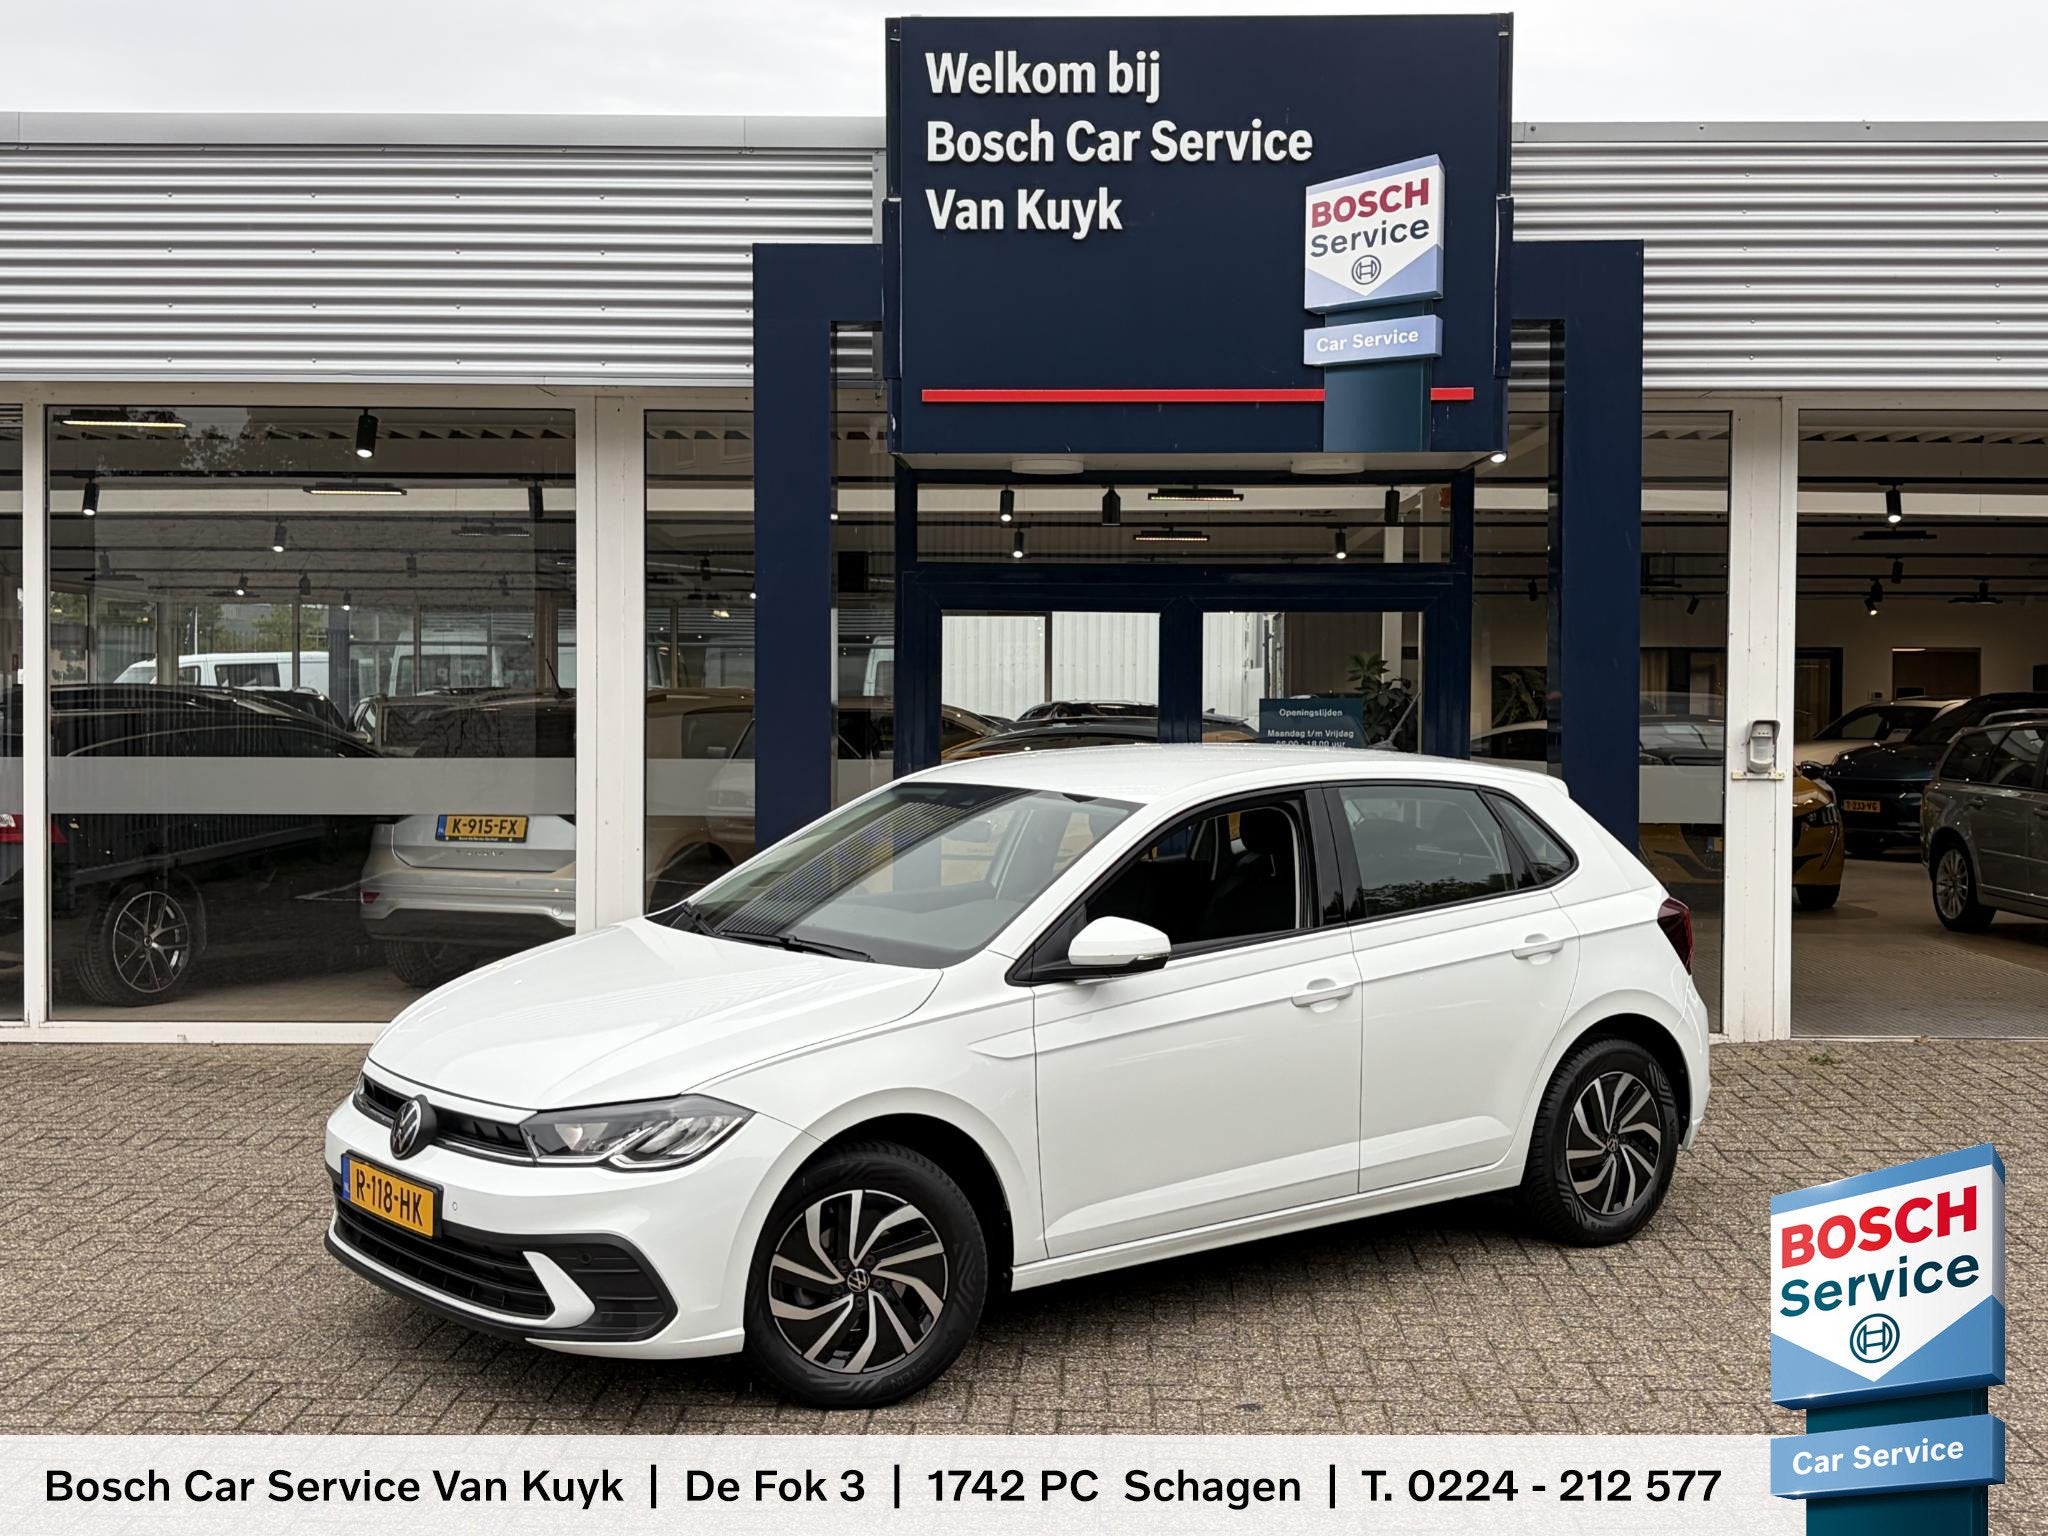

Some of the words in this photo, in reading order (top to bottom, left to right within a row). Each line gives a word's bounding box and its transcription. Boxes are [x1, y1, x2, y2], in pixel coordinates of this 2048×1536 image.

[925, 50, 1096, 95] Welkom
[1108, 50, 1160, 104] bij
[926, 119, 1054, 163] Bosch
[1066, 120, 1142, 162] Car
[1150, 118, 1313, 162] Service
[926, 189, 1005, 231] Van
[1017, 187, 1123, 240] Kuyk
[1311, 178, 1430, 229] BOSCH
[1310, 215, 1431, 258] Service
[1316, 335, 1347, 354] Car
[1352, 328, 1419, 349] Service
[1267, 729, 1305, 739] Maandag
[1307, 729, 1323, 738] t/m
[1325, 729, 1354, 739] Vrijdag
[1279, 708, 1343, 718] Openingstijden
[452, 818, 518, 835] K-915-FX
[356, 1168, 423, 1226] R-118-HK
